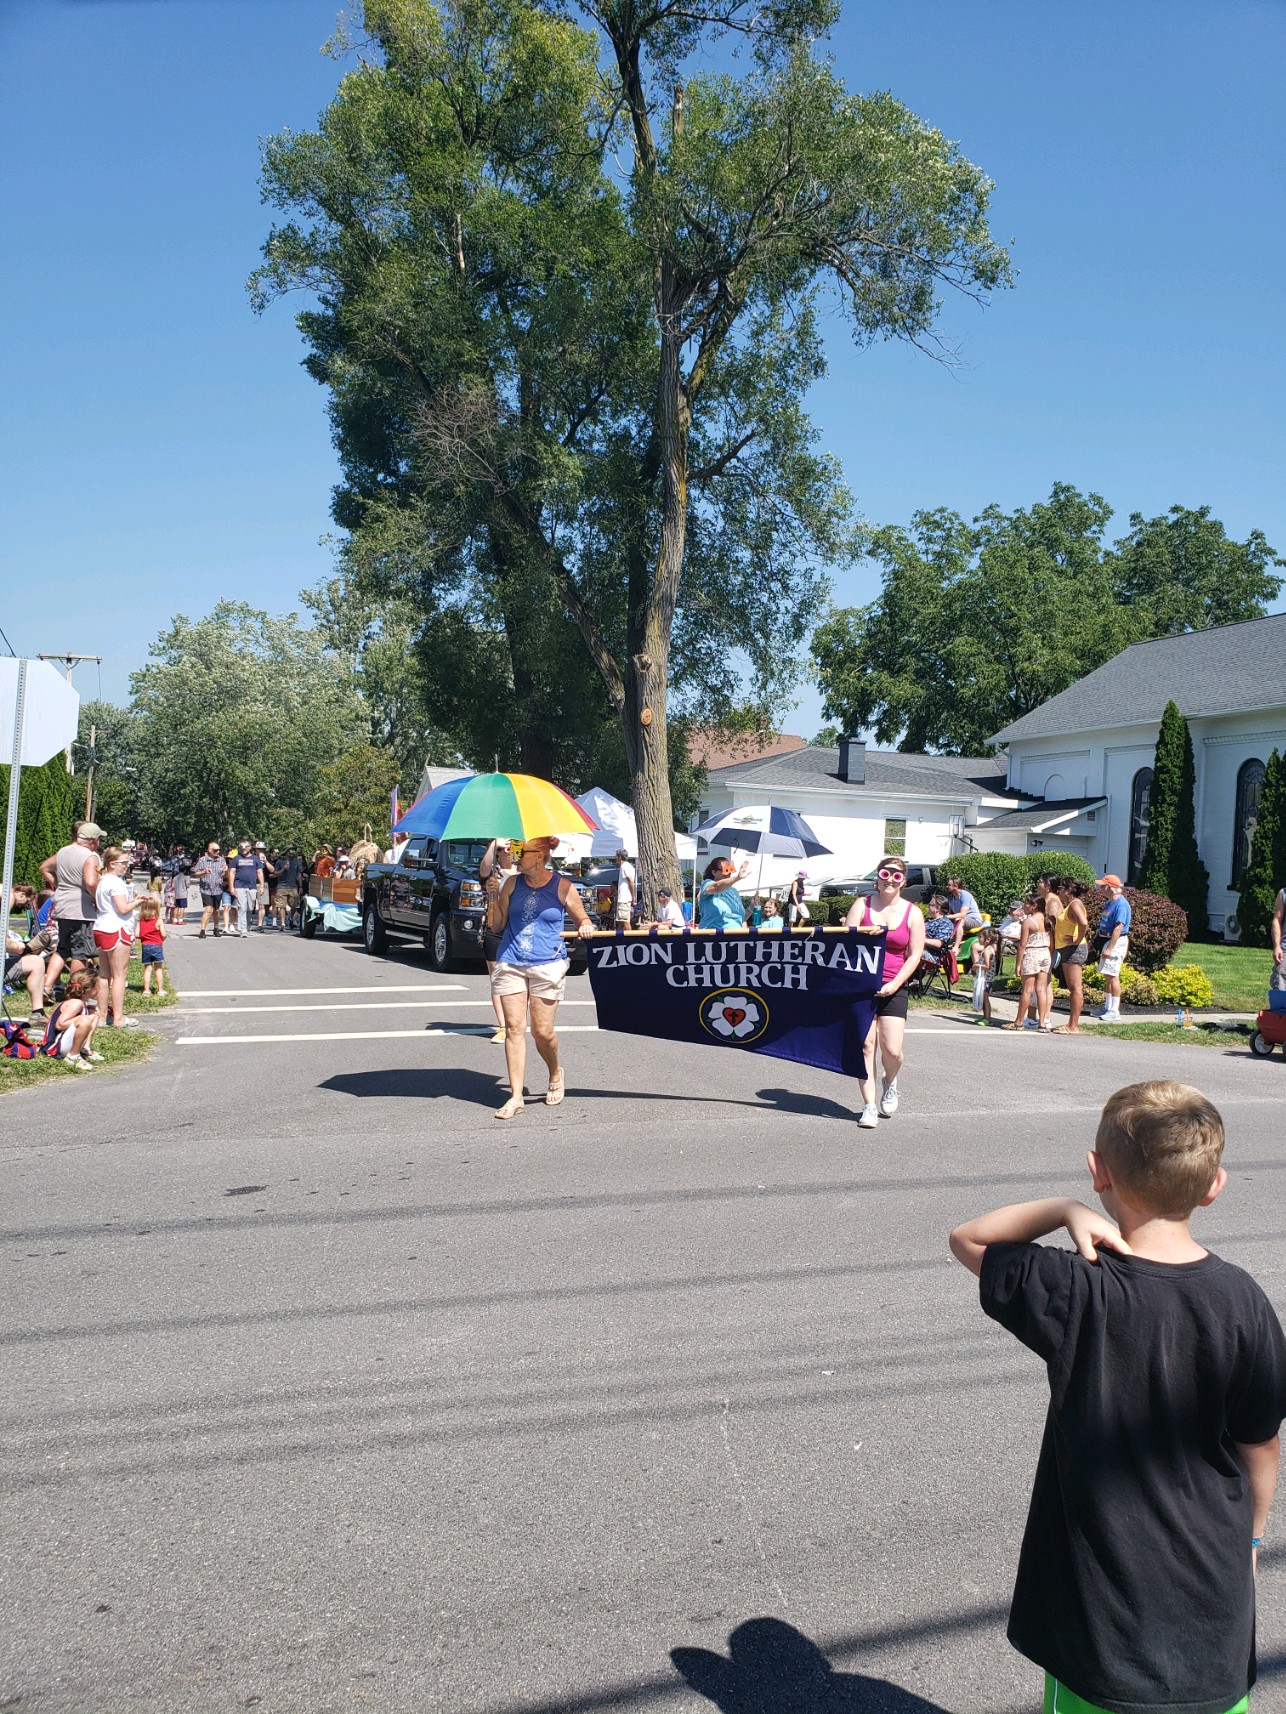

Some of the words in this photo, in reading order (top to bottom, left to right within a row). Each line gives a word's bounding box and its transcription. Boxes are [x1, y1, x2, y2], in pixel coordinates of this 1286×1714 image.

[592, 942, 673, 968] ZION
[686, 940, 881, 974] LUTHERAN
[666, 963, 808, 990] CHURCH
